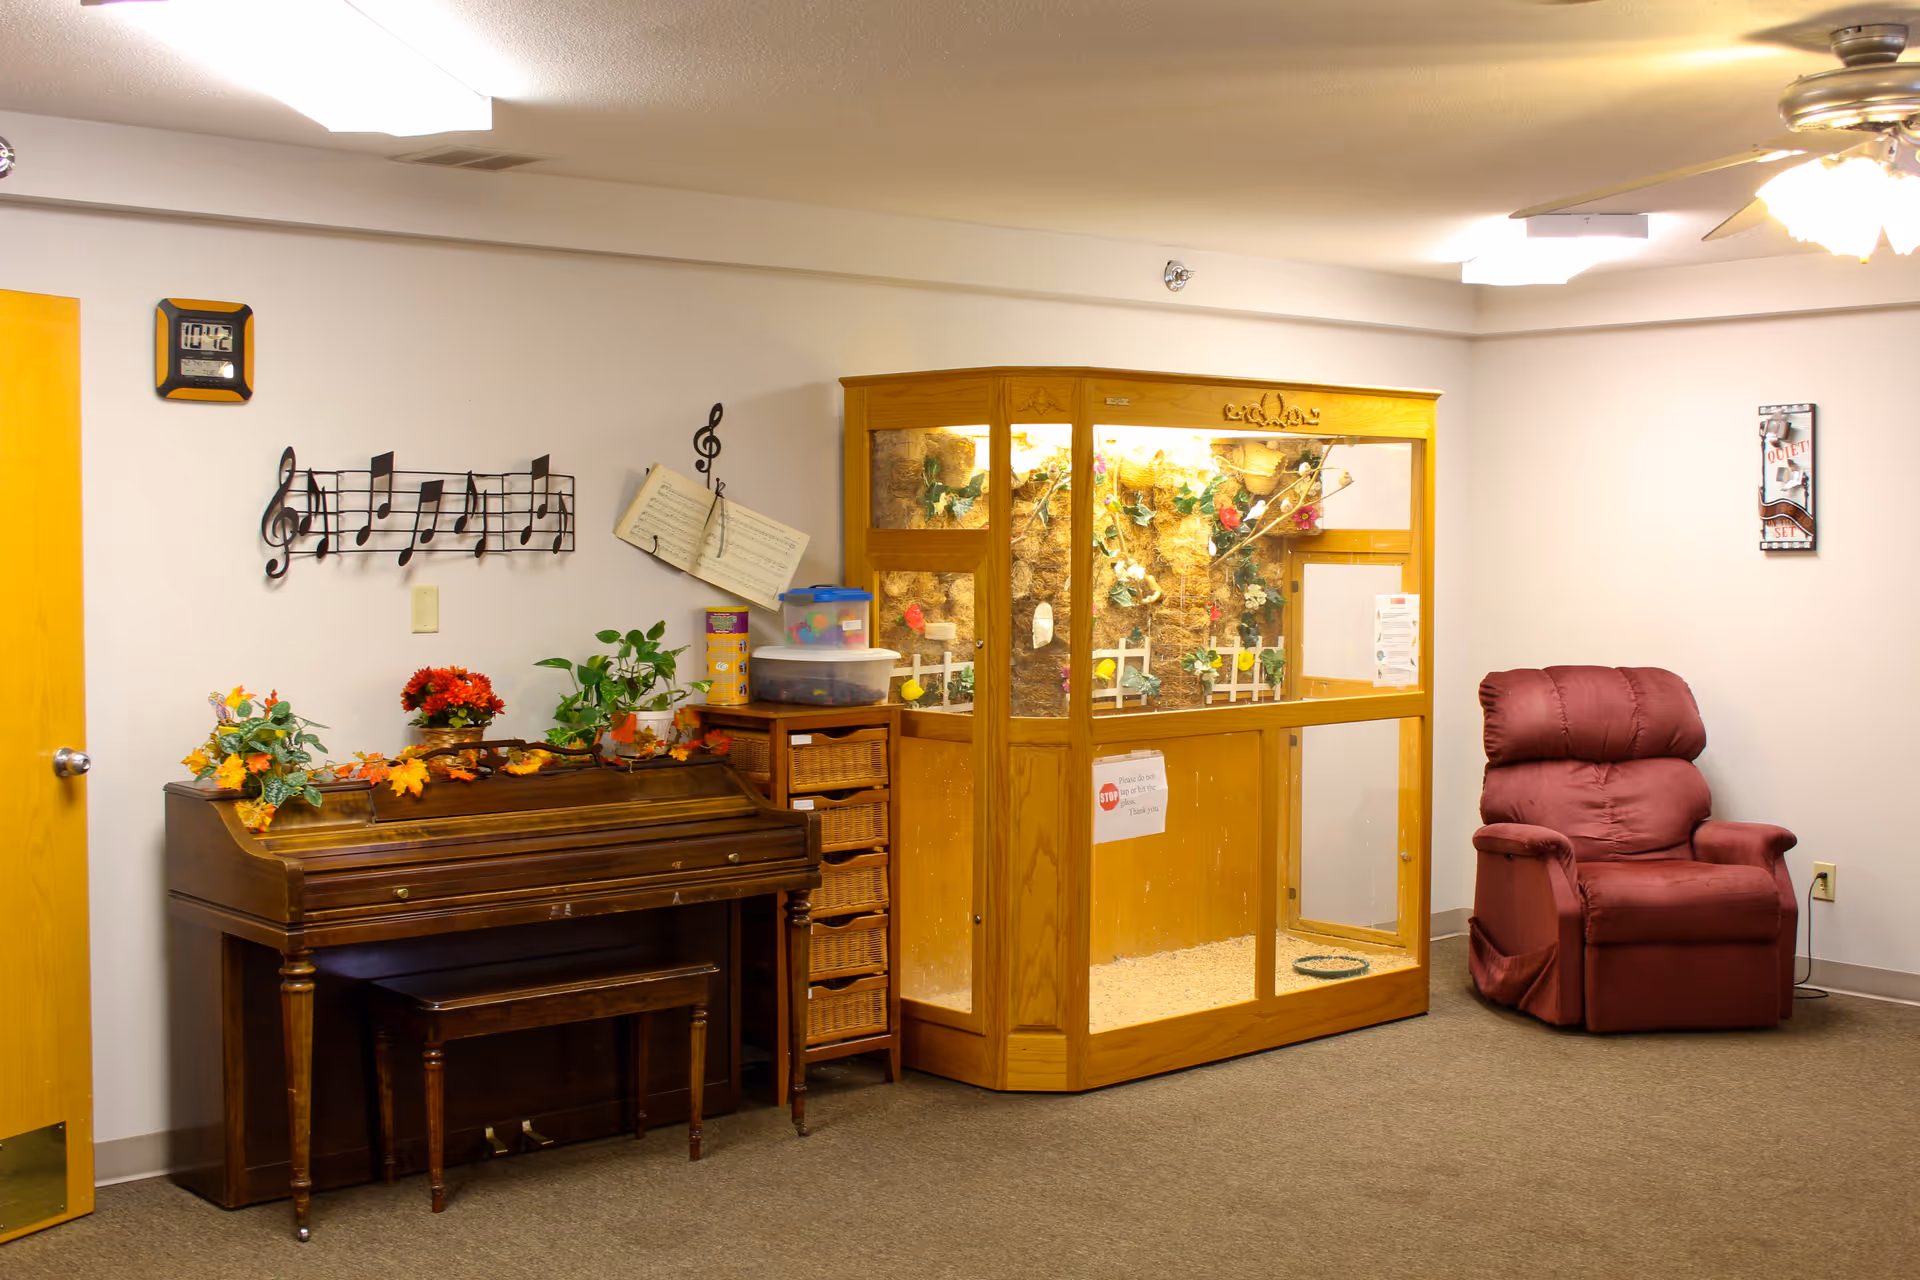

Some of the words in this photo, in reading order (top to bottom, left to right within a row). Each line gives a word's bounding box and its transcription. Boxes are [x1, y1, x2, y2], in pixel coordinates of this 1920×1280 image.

[1774, 526, 1796, 538] SET
[1119, 776, 1136, 784] Please
[1137, 785, 1146, 793] hit
[1100, 791, 1118, 803] STOP
[1129, 806, 1146, 816] Thank
